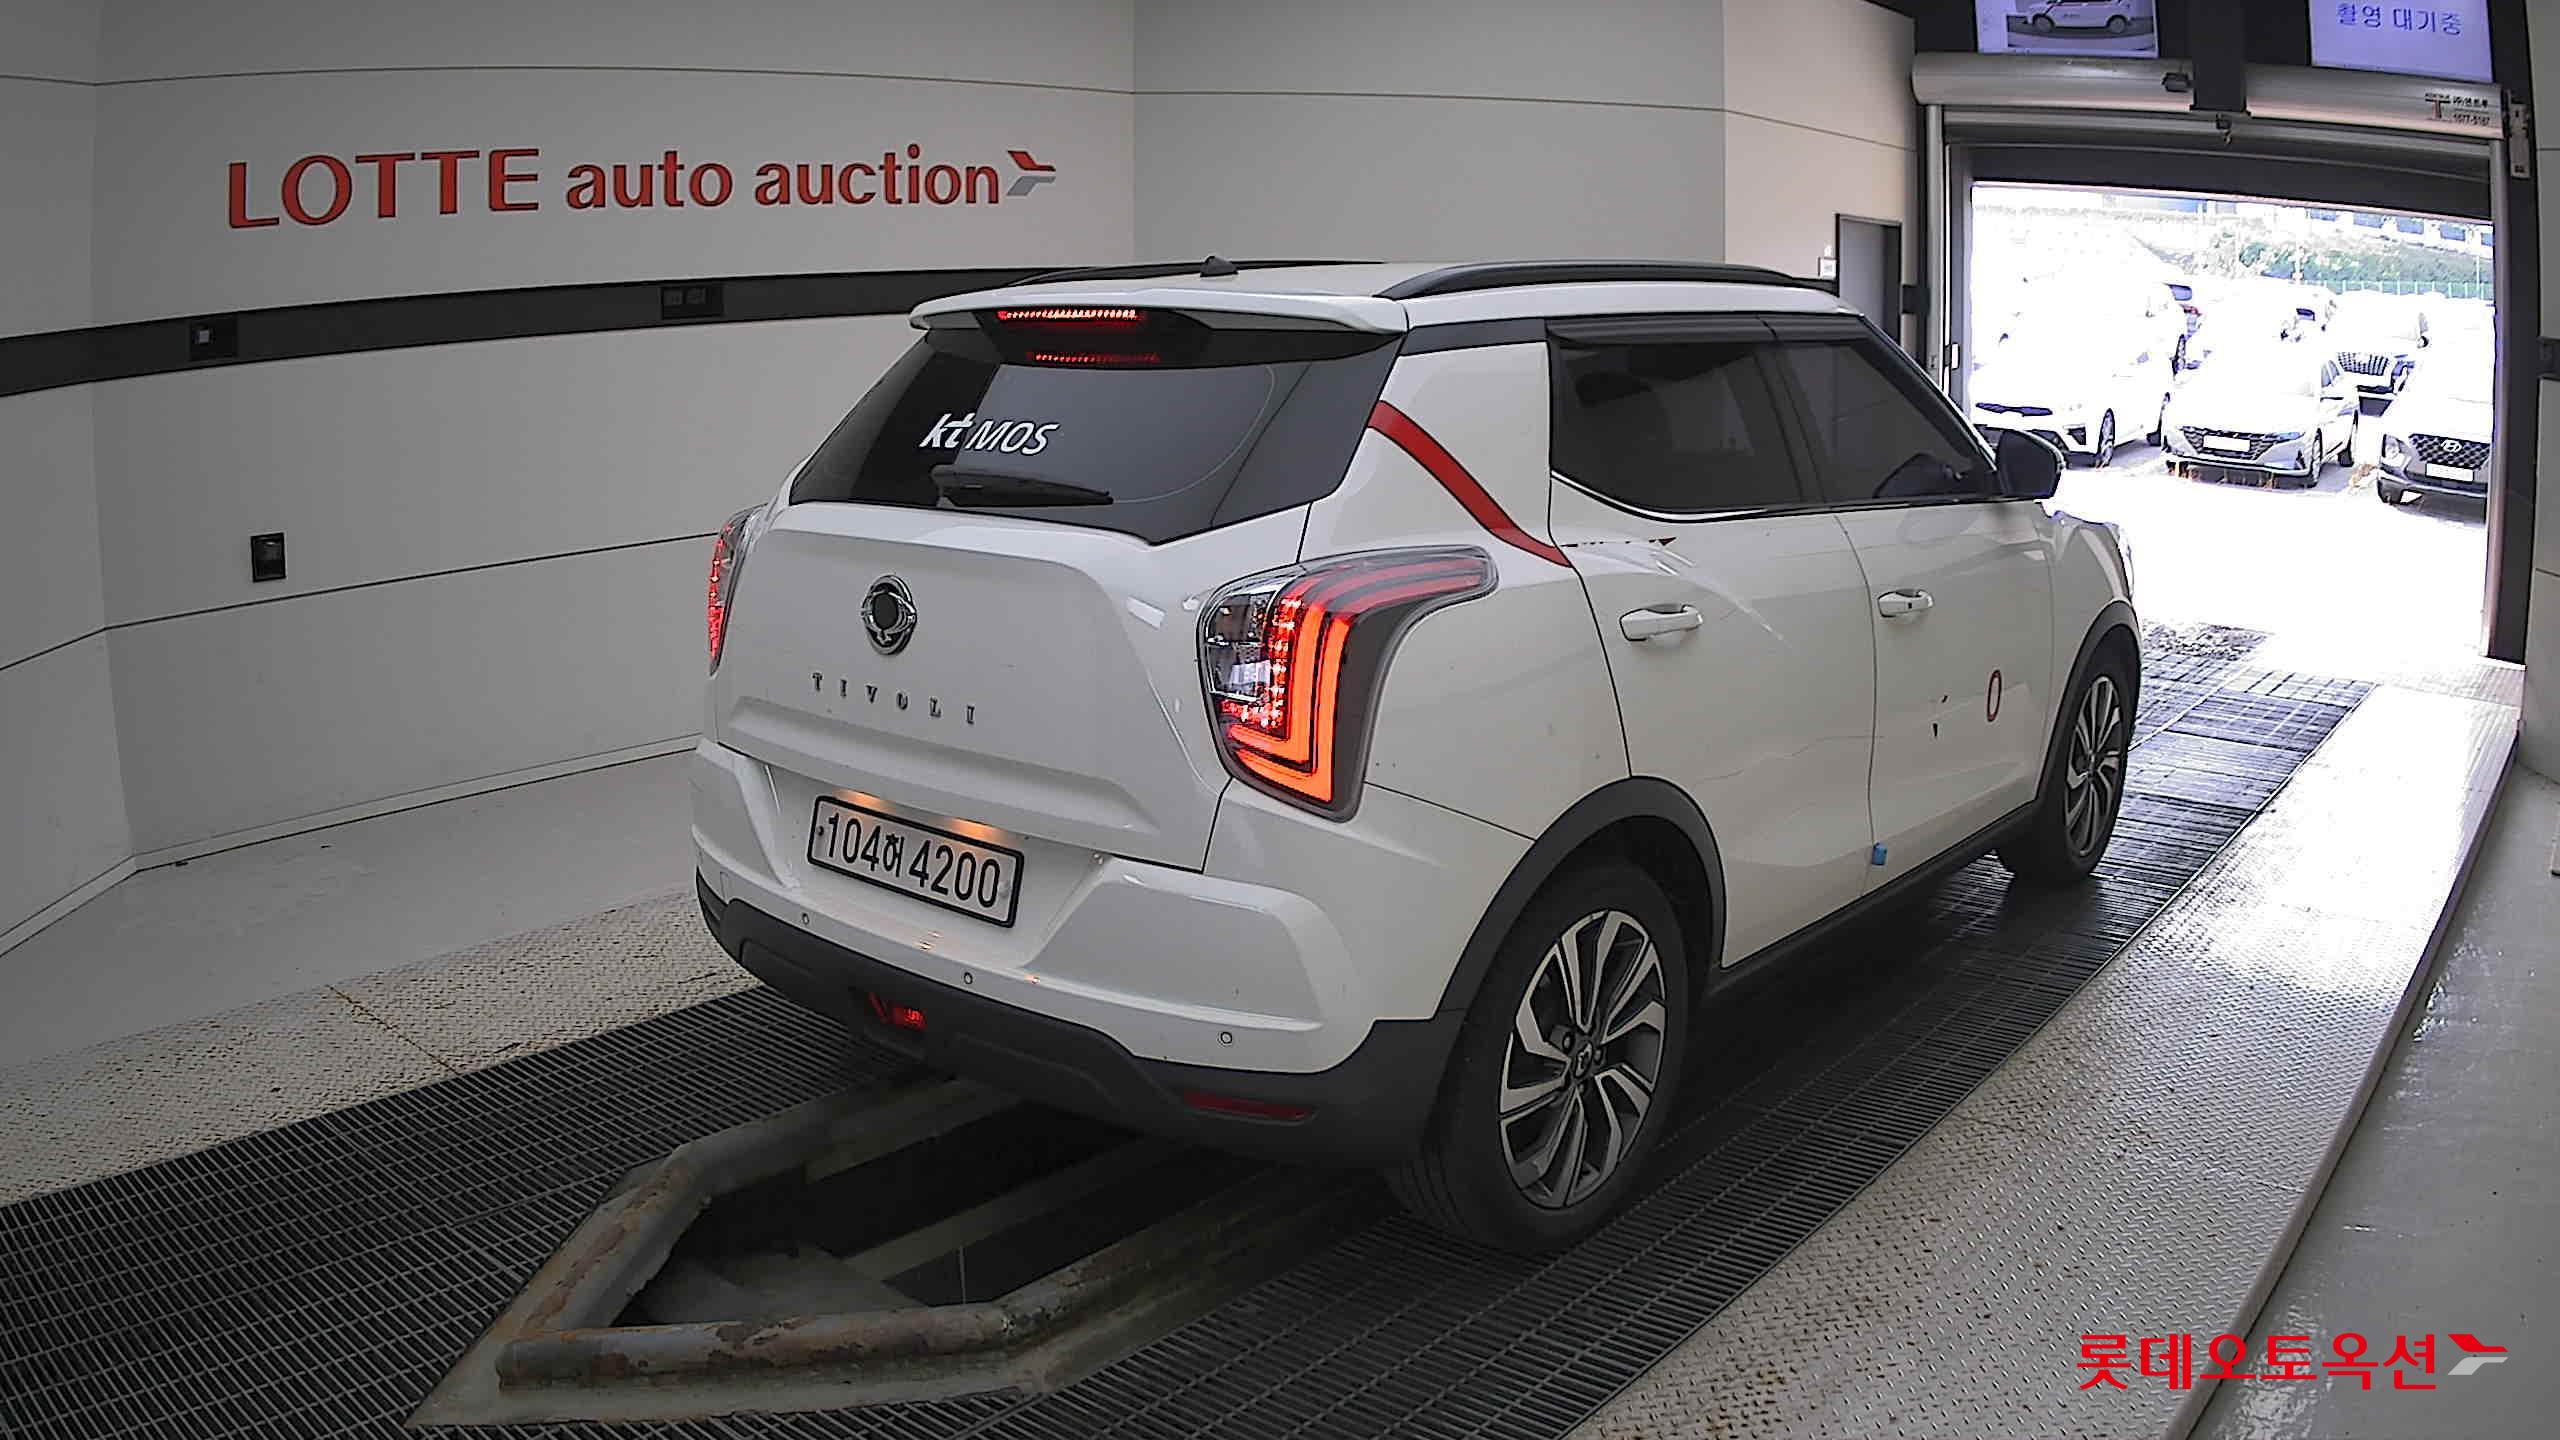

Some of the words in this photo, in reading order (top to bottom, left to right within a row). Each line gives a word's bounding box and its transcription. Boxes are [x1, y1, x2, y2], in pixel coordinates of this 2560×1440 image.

[2393, 8, 2462, 35] 대기중
[228, 148, 540, 229] LOTTE
[565, 149, 733, 209] auto
[754, 143, 999, 205] auction
[919, 412, 976, 449] kt
[964, 419, 1061, 455] MOS
[811, 671, 976, 725] TIVOLI
[828, 812, 904, 878] 104허
[908, 839, 1001, 908] 4200
